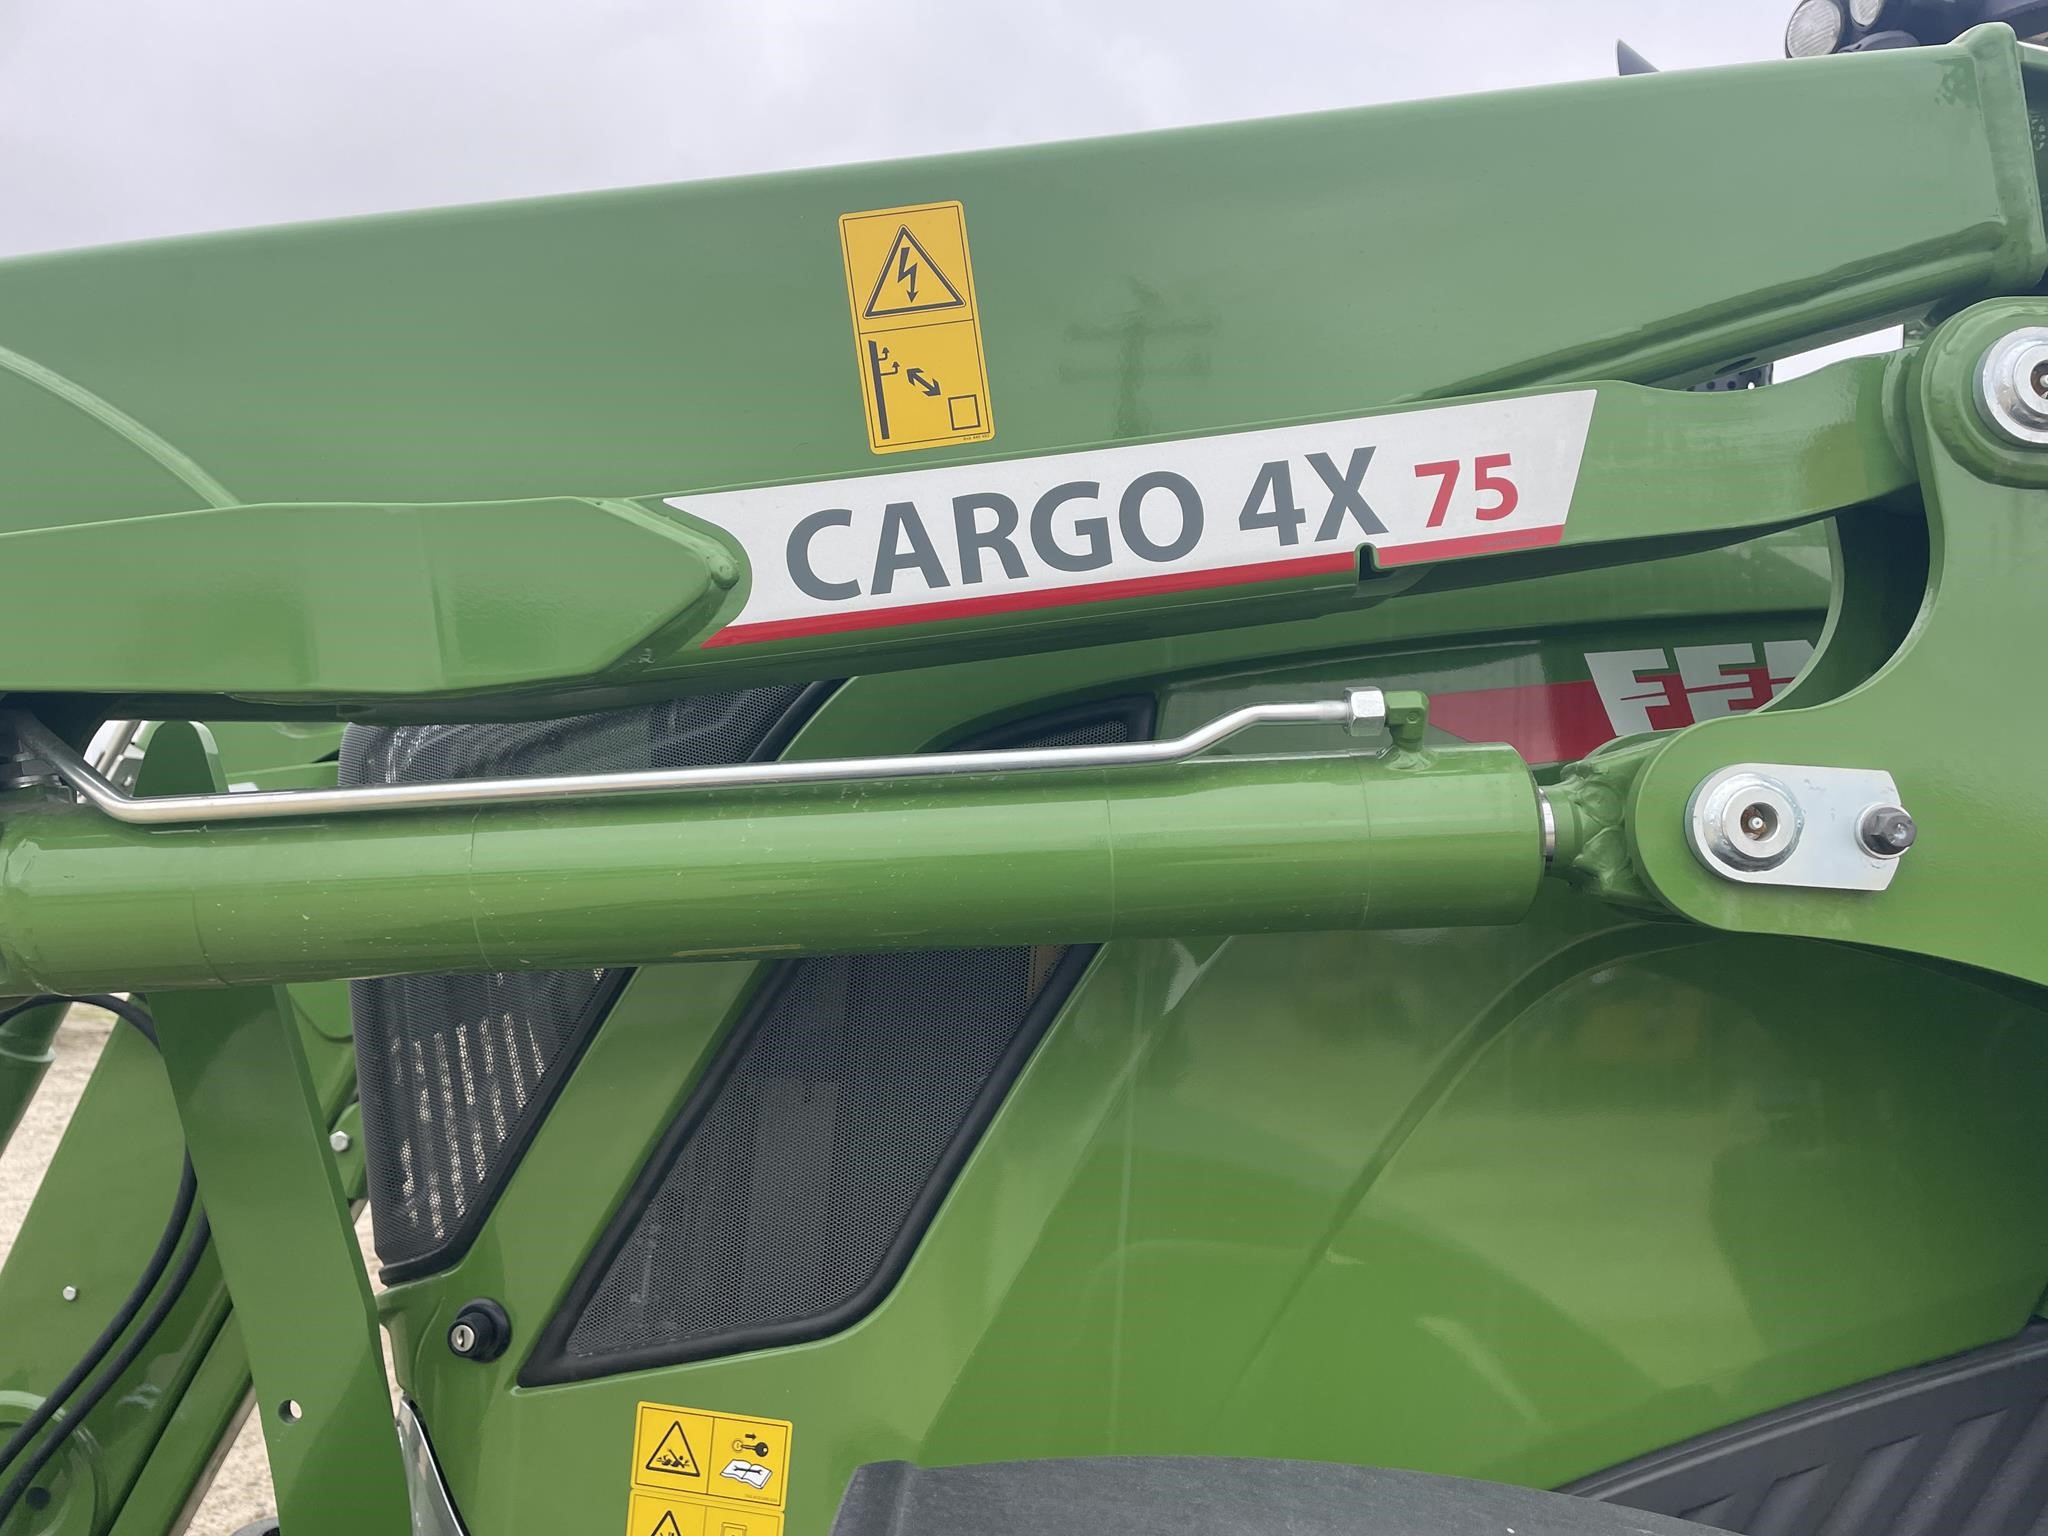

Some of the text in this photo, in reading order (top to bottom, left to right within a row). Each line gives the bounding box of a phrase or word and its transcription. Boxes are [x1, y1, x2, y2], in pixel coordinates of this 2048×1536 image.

[786, 445, 1518, 601] CARGO 4X 75
